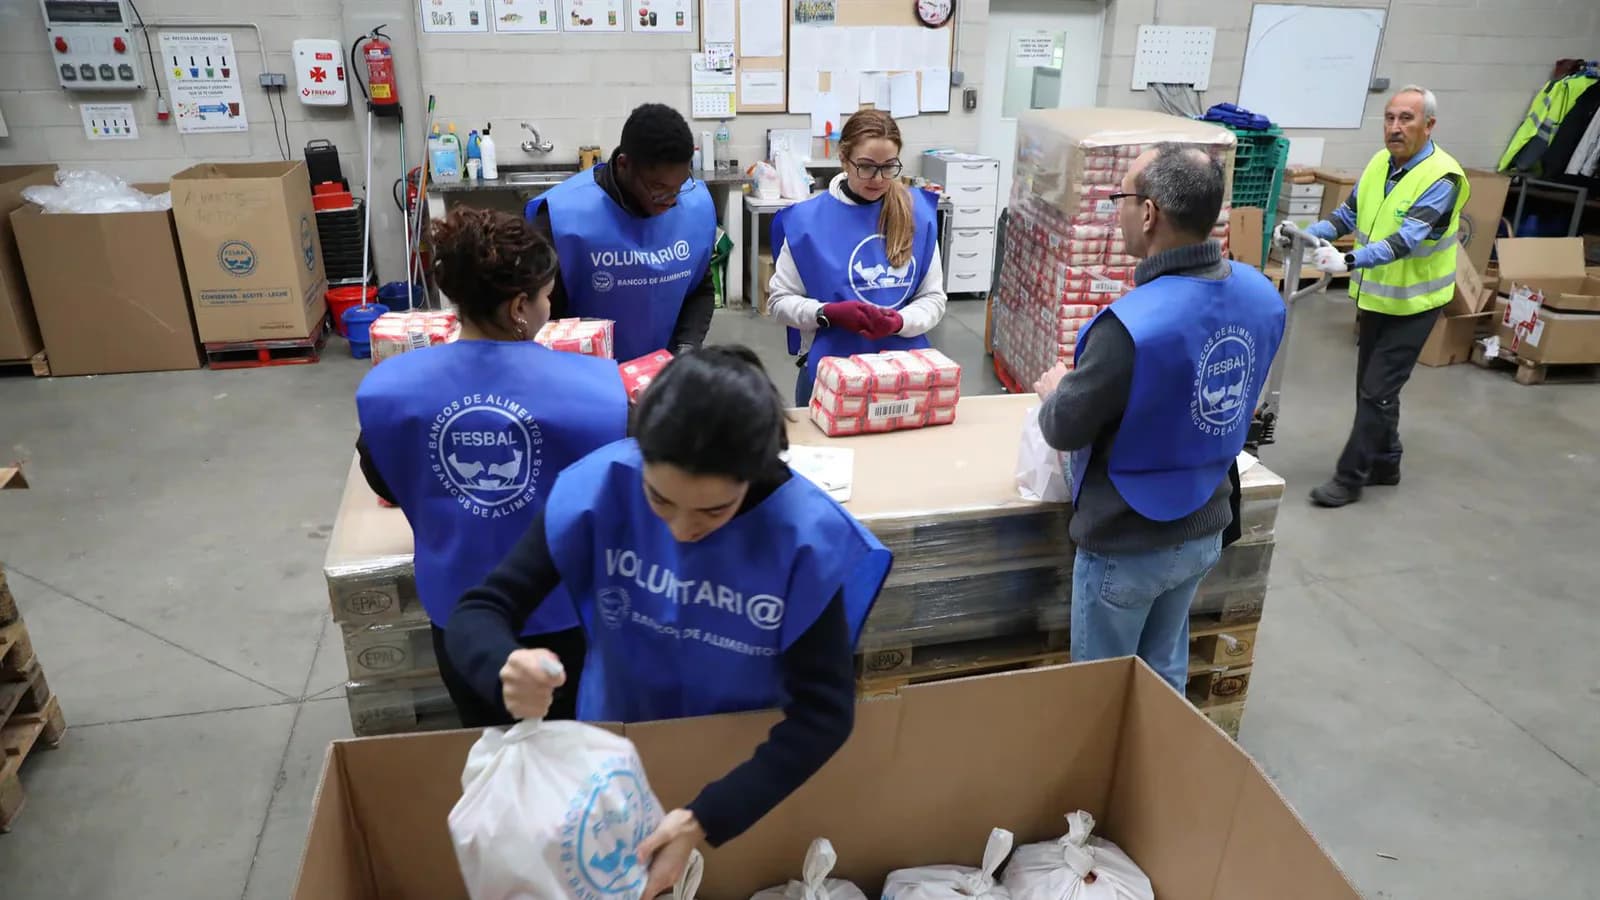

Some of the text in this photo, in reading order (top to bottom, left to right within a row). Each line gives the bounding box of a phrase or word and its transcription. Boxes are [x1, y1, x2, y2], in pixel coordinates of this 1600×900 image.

[590, 240, 690, 267] VOLUNTARI@
[617, 278, 648, 287] BANCOS
[649, 277, 659, 285] DE
[659, 270, 692, 283] ALIMENTOS
[200, 293, 238, 301] CONSERVAS
[1193, 337, 1215, 387] BANCOS
[1215, 327, 1227, 339] DE
[1207, 354, 1246, 379] FESBAL
[428, 393, 543, 449] BANCOS DE ALIMENTOS
[1189, 400, 1212, 435] BANCOS
[1213, 427, 1226, 437] DE
[451, 431, 518, 447] FESBAL
[431, 458, 542, 519] BANCOS DE ALIMENTOS
[605, 549, 785, 631] VOLUNTARI@
[682, 628, 701, 640] DE
[364, 651, 396, 666] EPAL
